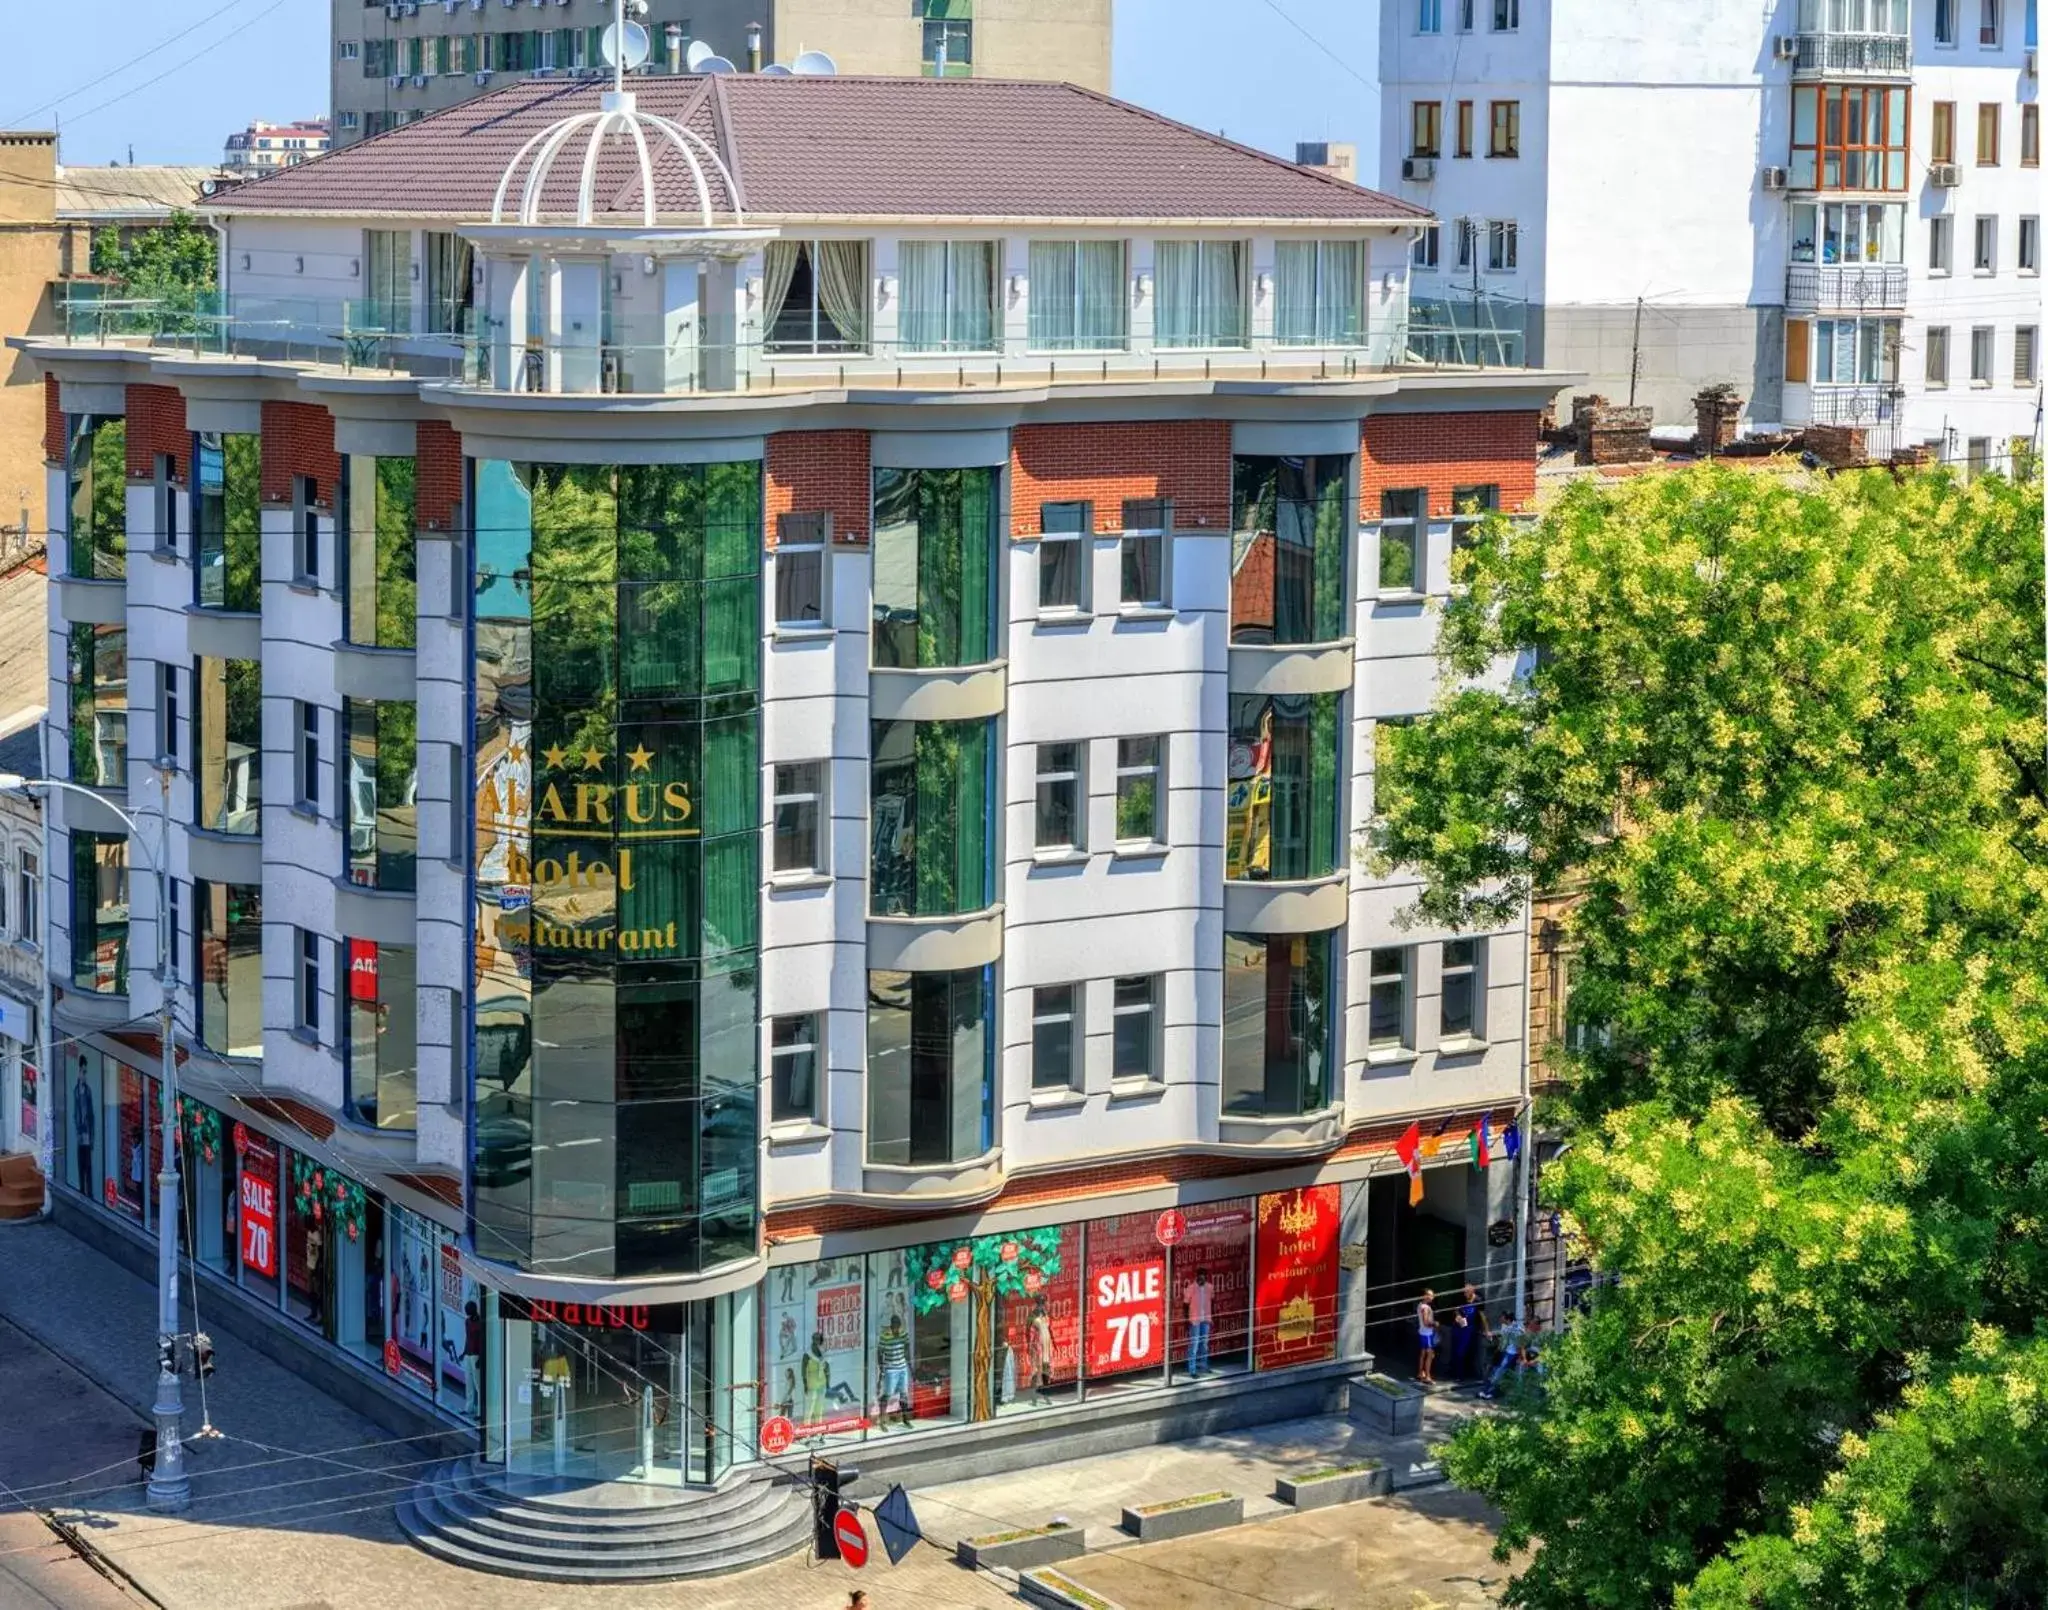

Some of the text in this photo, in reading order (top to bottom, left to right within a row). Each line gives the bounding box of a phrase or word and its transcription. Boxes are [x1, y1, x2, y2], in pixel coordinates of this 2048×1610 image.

[494, 919, 678, 951] taurant
[242, 1177, 272, 1217] SALE
[1279, 1236, 1316, 1256] hotel
[1098, 1266, 1160, 1307] SALE
[1268, 1262, 1328, 1281] restaurant
